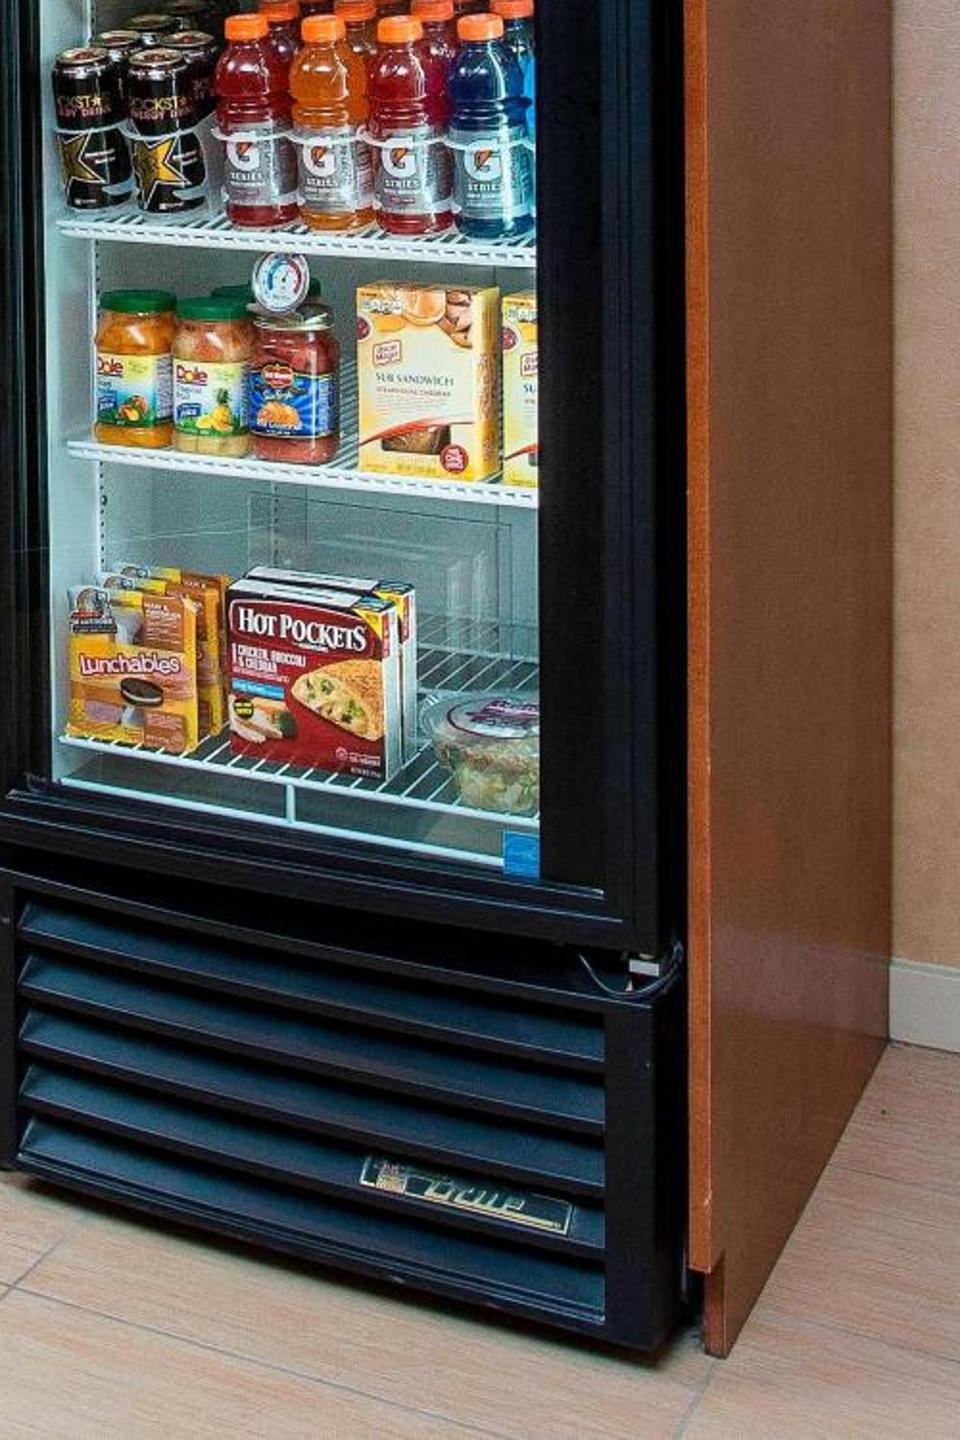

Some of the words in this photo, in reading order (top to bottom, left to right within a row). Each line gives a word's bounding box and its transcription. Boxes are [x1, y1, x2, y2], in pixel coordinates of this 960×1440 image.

[176, 364, 208, 380] Dole
[238, 607, 277, 637] HOT
[279, 613, 367, 652] POCKETS
[78, 652, 182, 676] Lunchables
